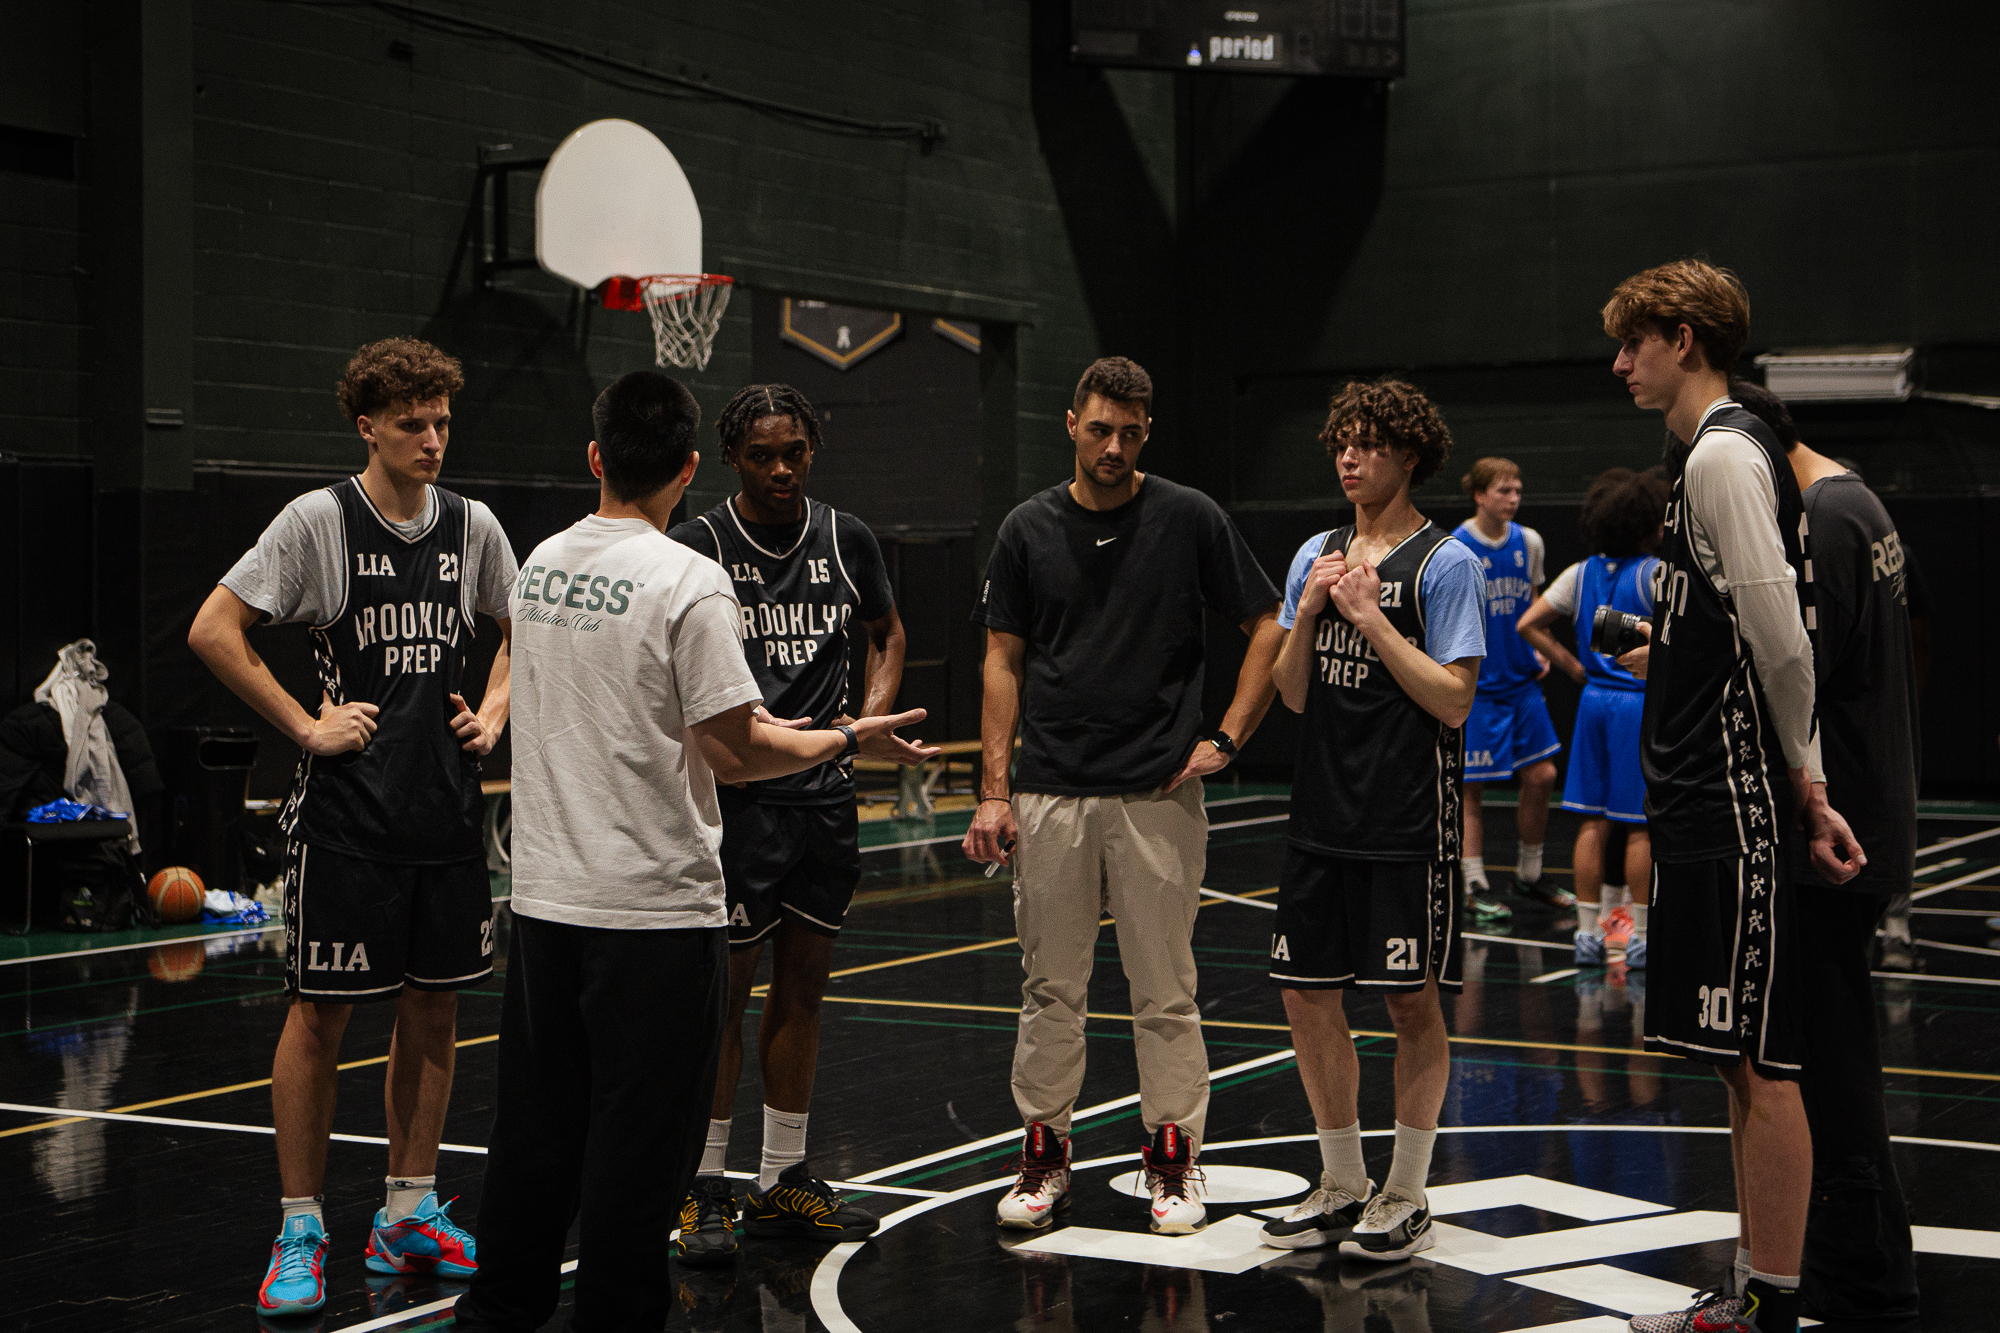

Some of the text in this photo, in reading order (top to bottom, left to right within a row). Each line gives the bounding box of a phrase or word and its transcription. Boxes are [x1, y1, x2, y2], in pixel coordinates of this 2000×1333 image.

[357, 553, 396, 577] LIA
[438, 553, 459, 582] 23
[731, 562, 765, 585] LIA
[808, 558, 830, 584] 15
[517, 566, 633, 616] RECESS
[1380, 582, 1402, 608] 21
[516, 603, 603, 632] Athletics Club
[384, 643, 441, 677] PREP
[764, 639, 818, 667] PREP
[1320, 656, 1369, 689] PREP
[1465, 750, 1494, 767] LIA
[308, 941, 371, 971] LIA
[1386, 938, 1420, 971] 21
[1699, 984, 1733, 1032] 30
